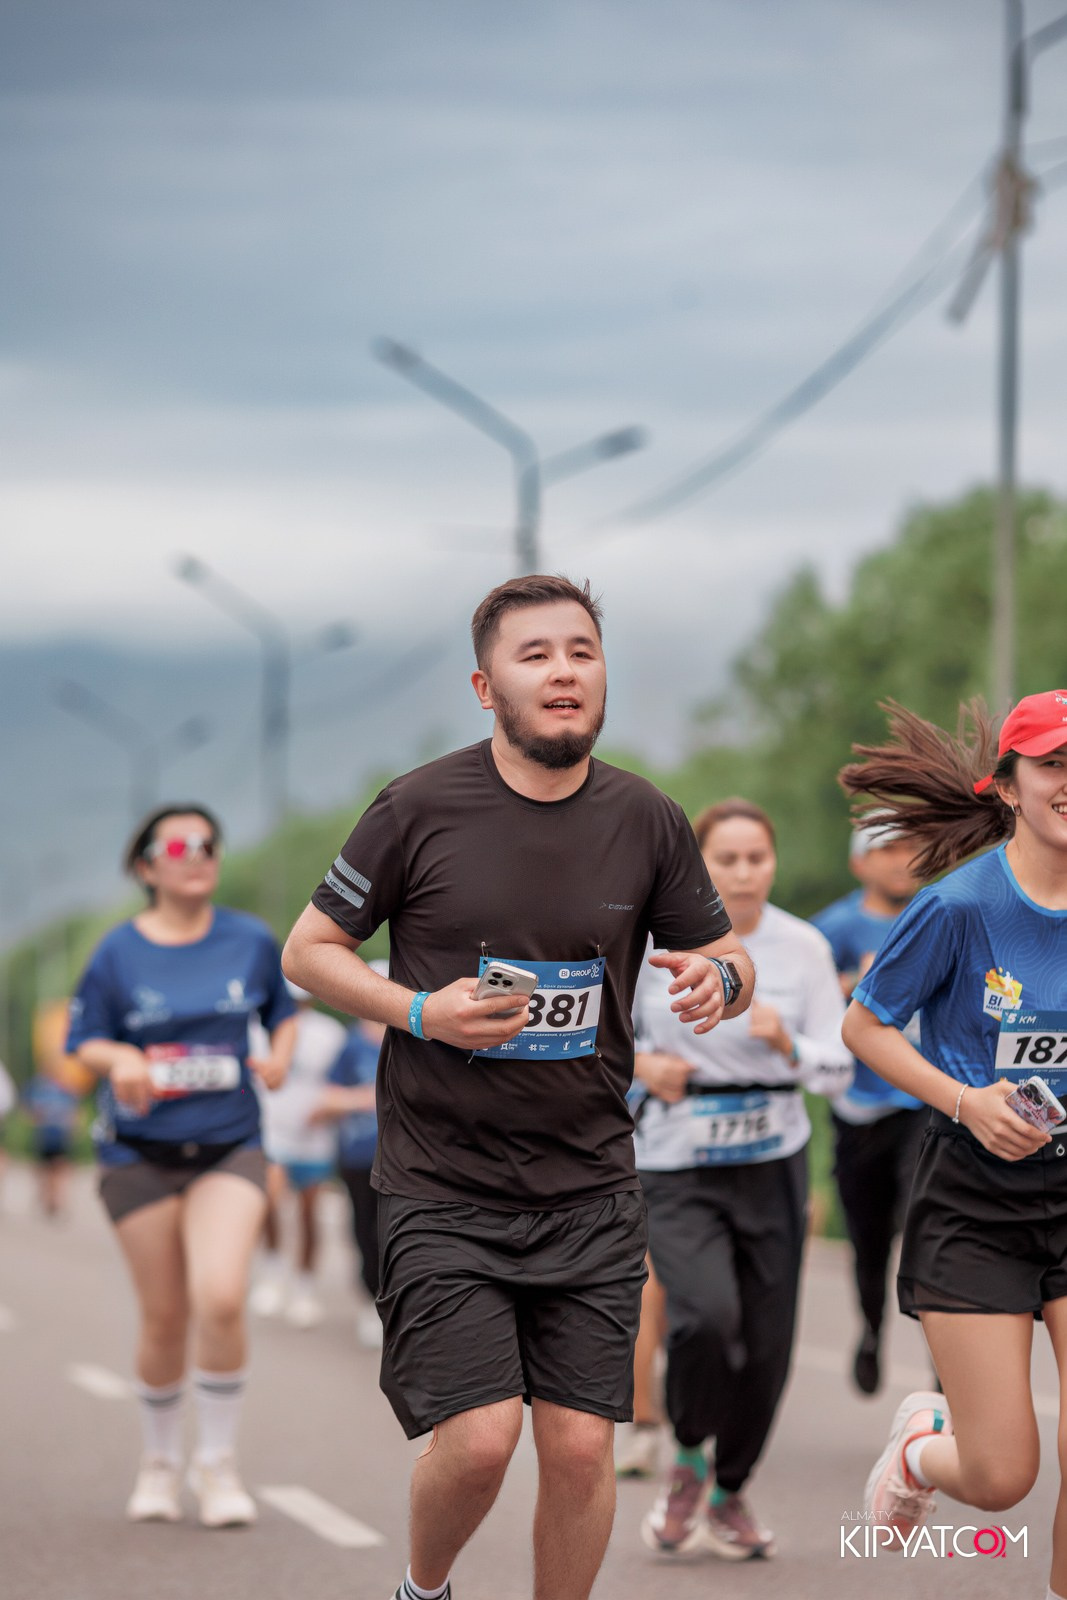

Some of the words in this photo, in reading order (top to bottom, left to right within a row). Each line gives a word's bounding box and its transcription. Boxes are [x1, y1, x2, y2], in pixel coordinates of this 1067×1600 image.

[571, 969, 591, 977] GROUP
[988, 994, 1003, 1007] BI
[1006, 1013, 1017, 1024] 5
